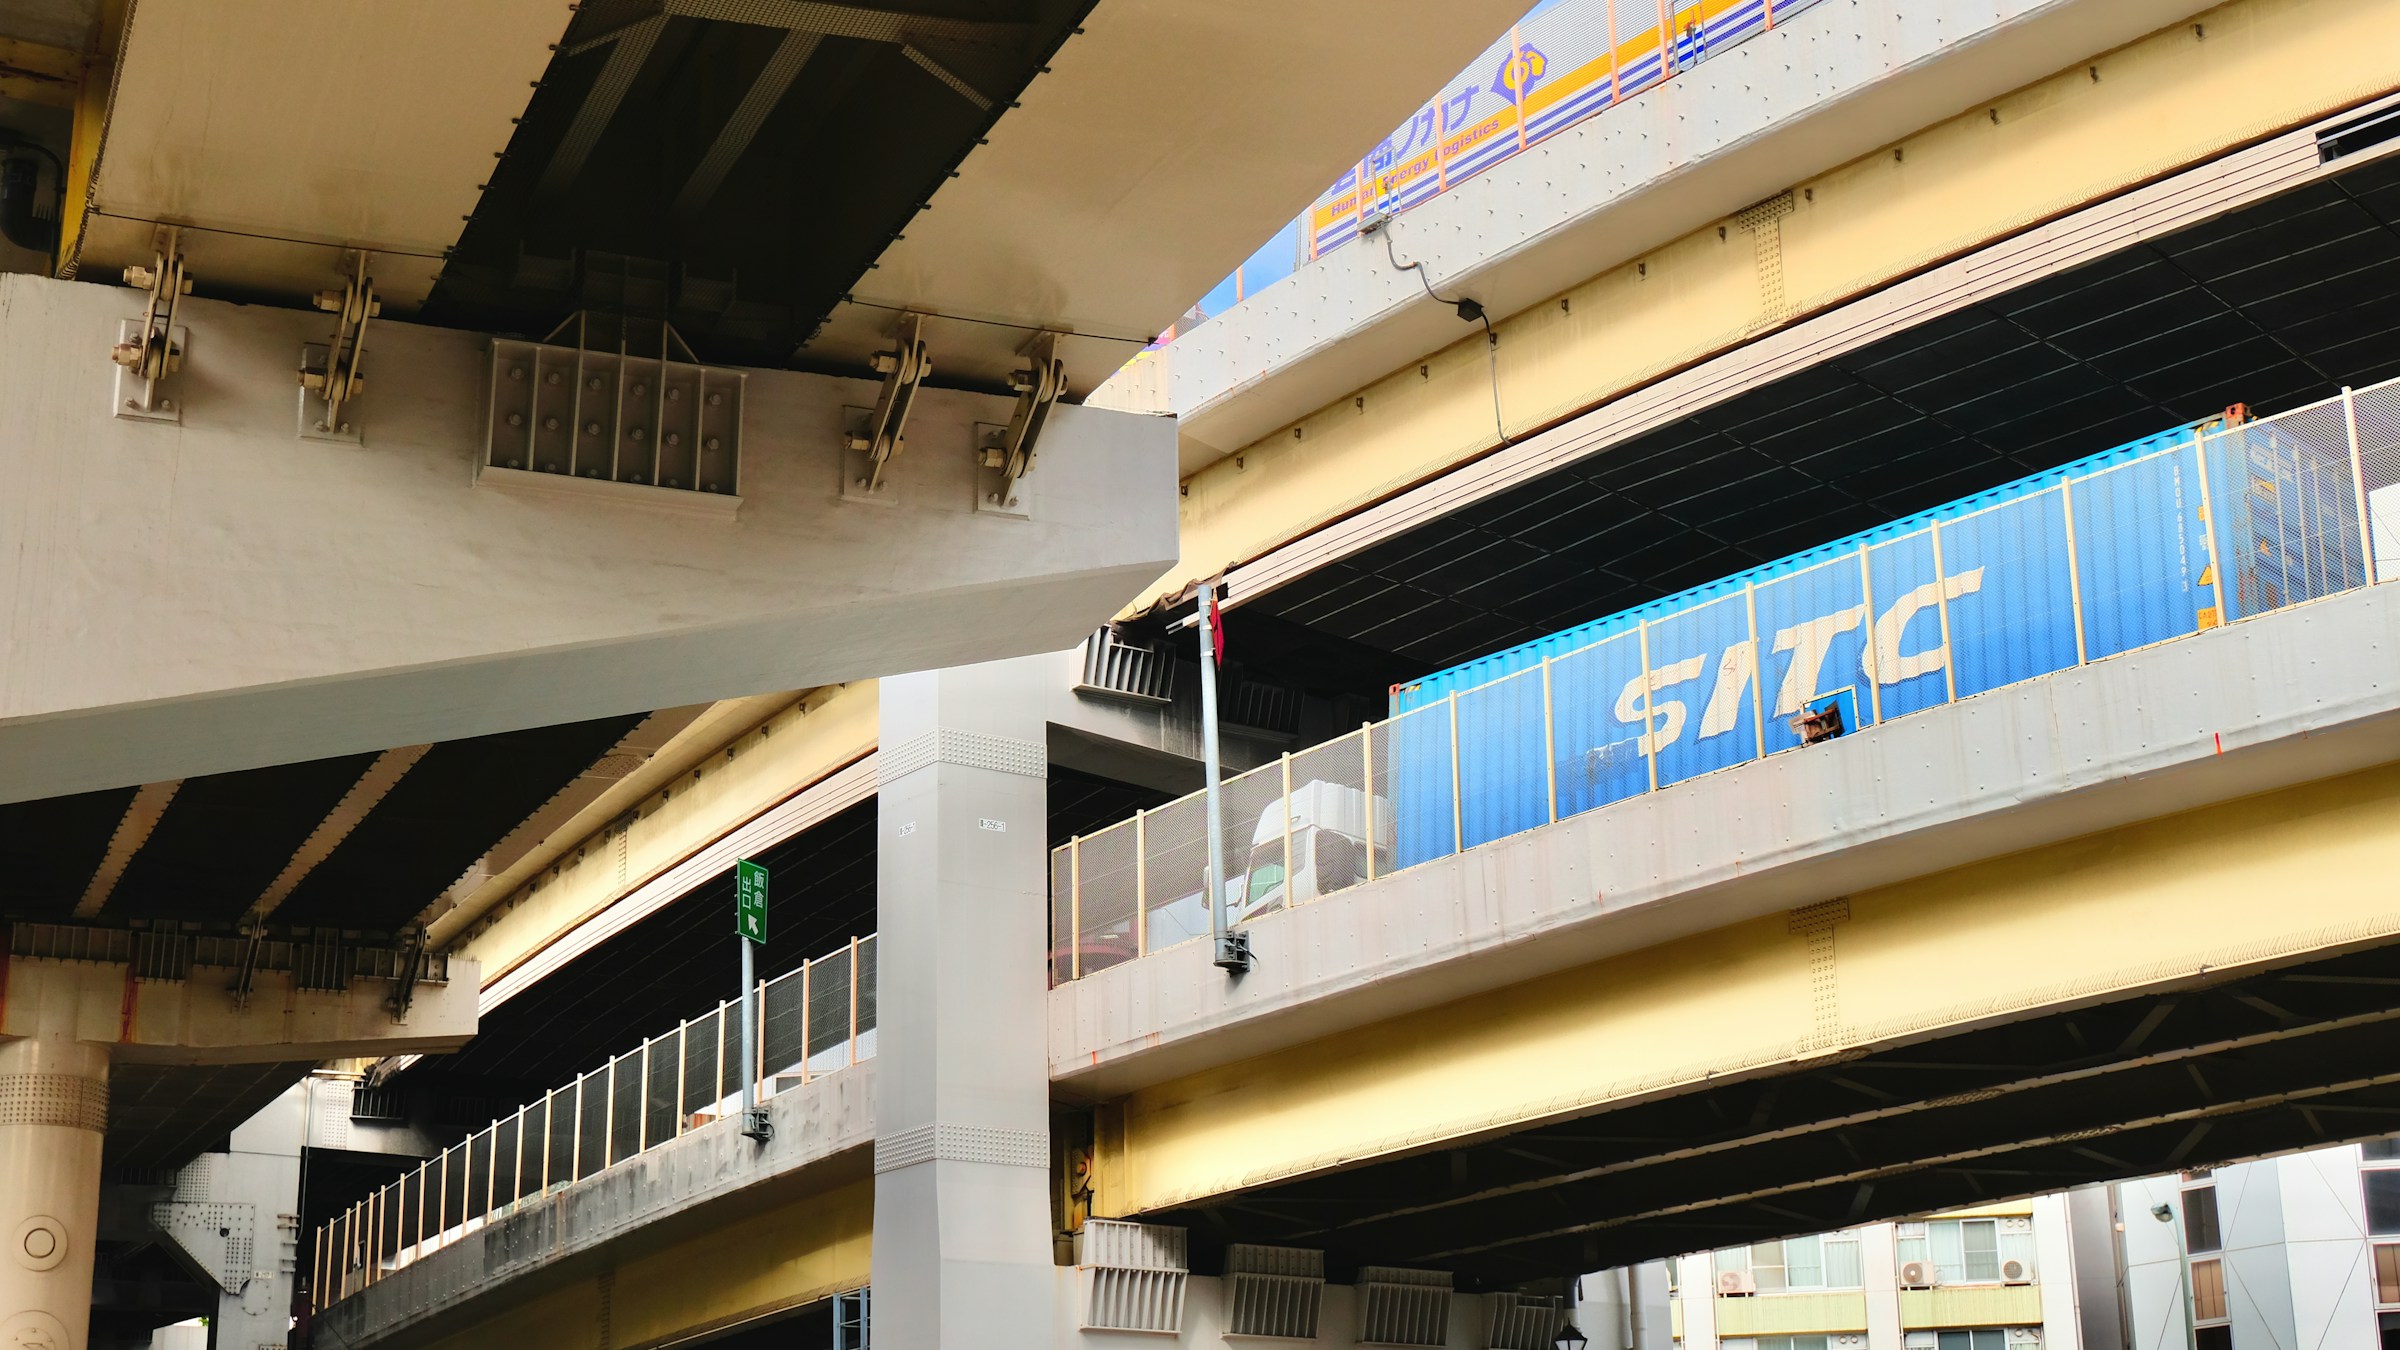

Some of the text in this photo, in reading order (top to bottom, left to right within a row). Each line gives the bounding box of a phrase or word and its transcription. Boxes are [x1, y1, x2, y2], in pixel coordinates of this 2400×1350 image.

[1614, 565, 1985, 757] SITC
[742, 876, 752, 910] 出口
[754, 871, 765, 909] 飯倉
